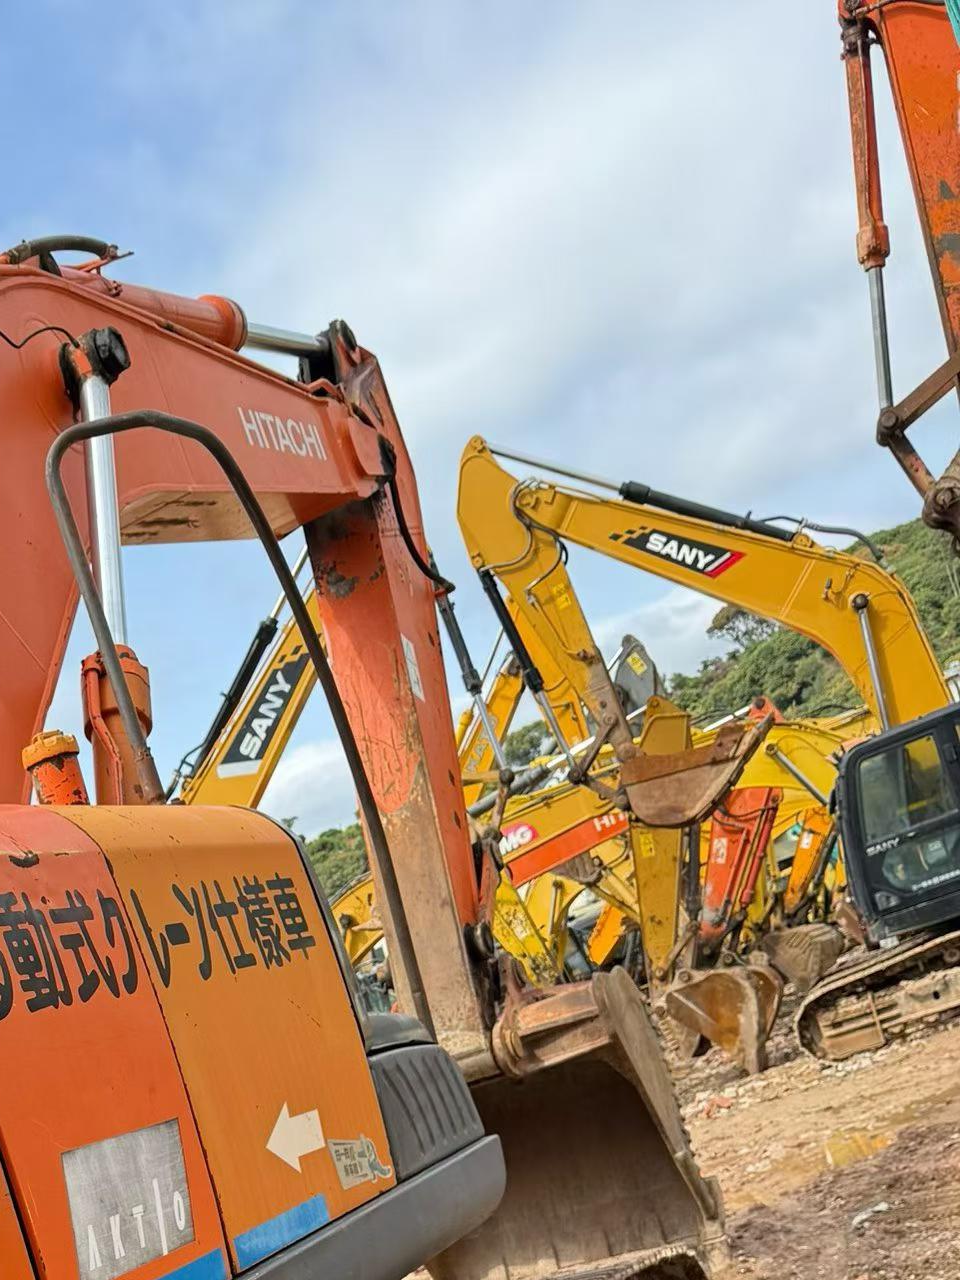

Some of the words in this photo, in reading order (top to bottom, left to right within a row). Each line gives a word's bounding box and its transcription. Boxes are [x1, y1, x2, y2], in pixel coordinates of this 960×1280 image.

[237, 406, 328, 461] HITACHI
[645, 532, 716, 570] SANY
[239, 670, 292, 760] SANY
[866, 837, 900, 857] SANY
